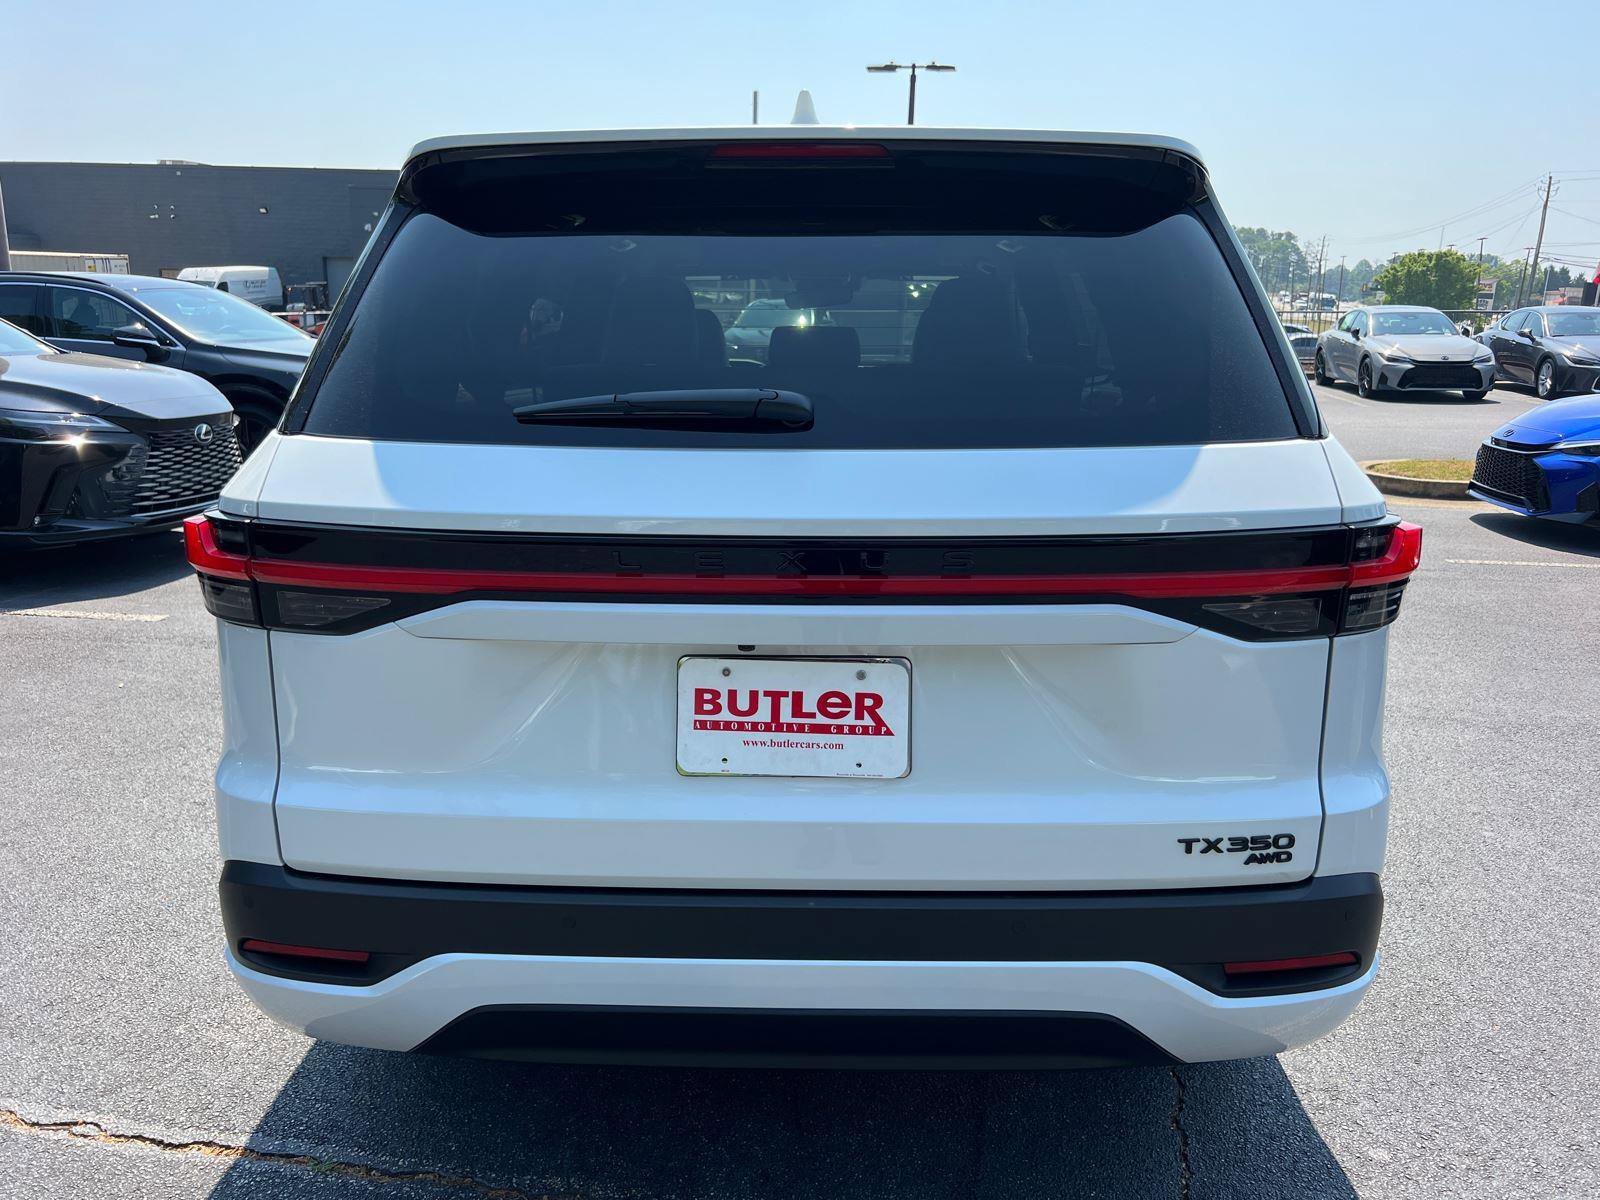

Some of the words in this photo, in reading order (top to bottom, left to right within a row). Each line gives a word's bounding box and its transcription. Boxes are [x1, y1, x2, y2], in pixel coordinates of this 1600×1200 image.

[611, 551, 977, 570] LEXUS
[694, 721, 811, 733] AUTOMOTIVE
[830, 725, 888, 735] GROUP
[742, 739, 845, 751] www.butlercars.com
[1243, 850, 1293, 866] AWD
